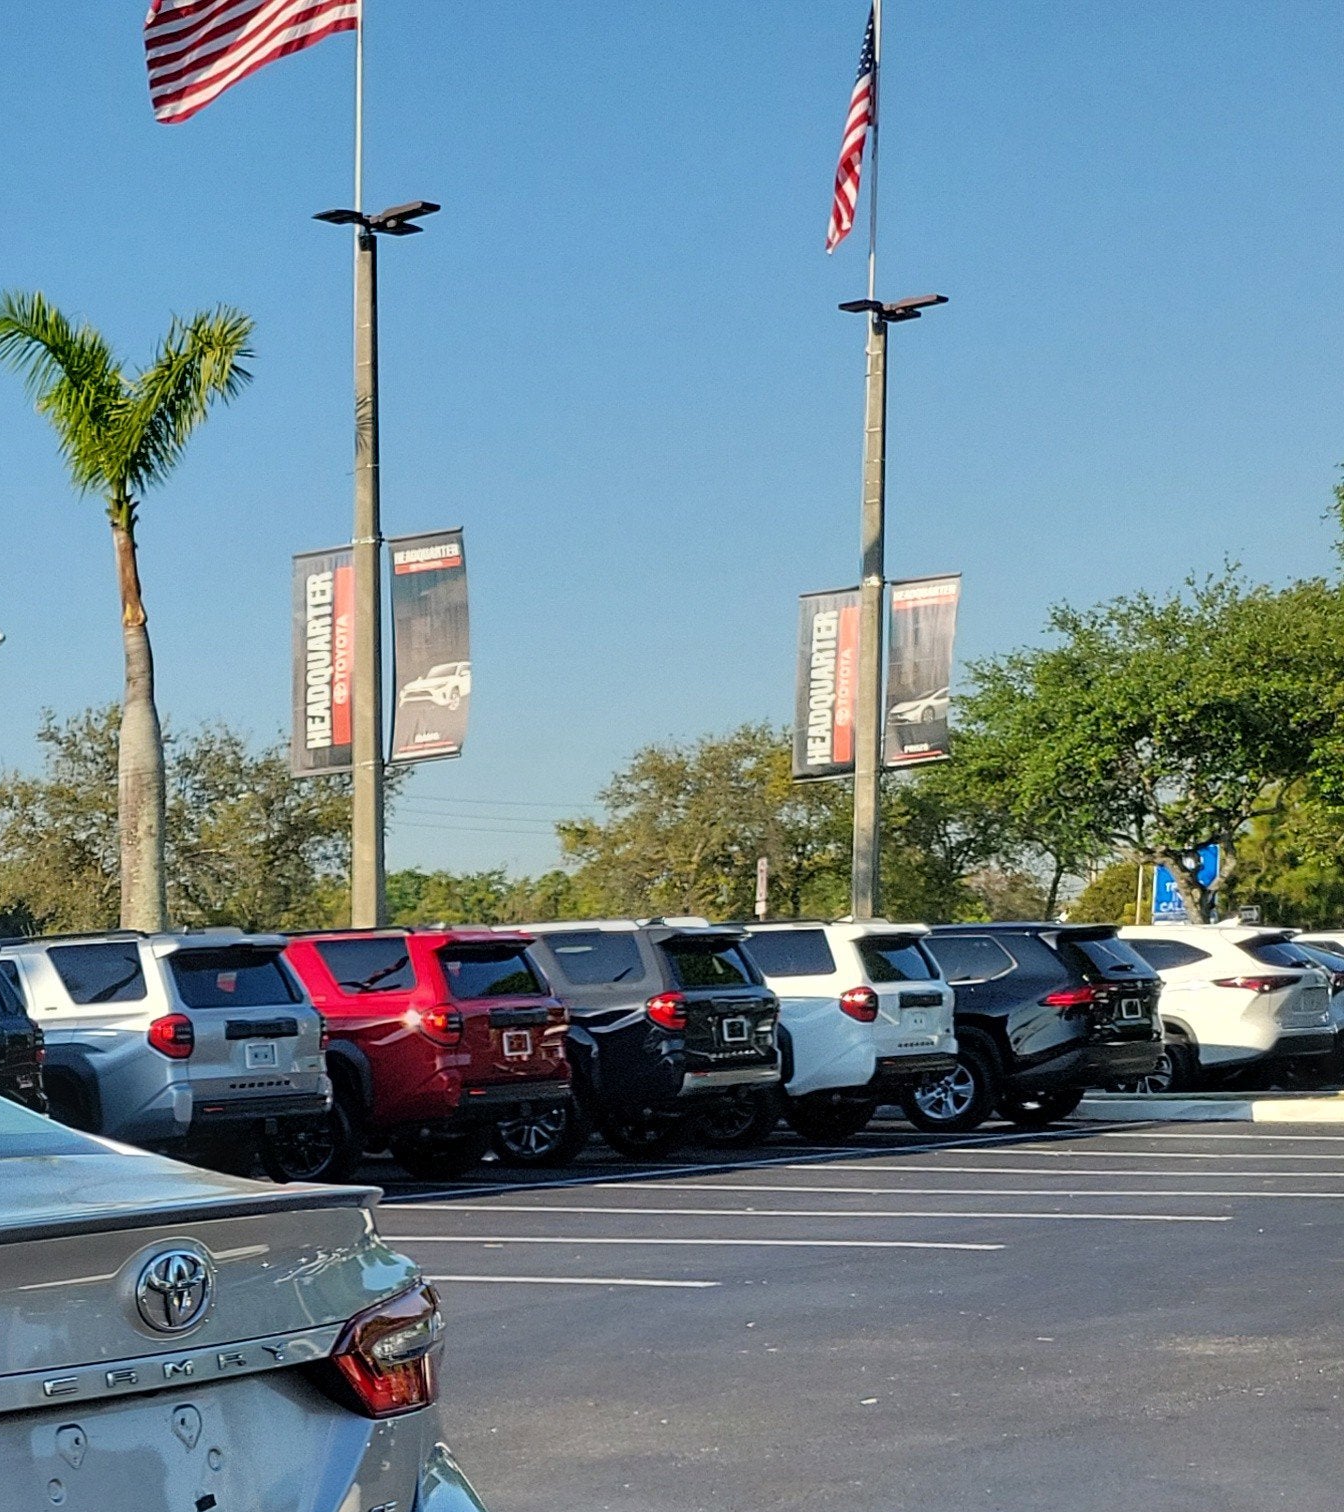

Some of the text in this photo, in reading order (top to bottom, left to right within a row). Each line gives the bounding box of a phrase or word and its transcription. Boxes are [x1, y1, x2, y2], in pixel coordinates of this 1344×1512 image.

[306, 571, 333, 749] HEADQUARTER
[334, 615, 349, 682] TOYOTA
[807, 610, 837, 765] HEADQUARTER
[42, 1342, 289, 1397] CAMRY
